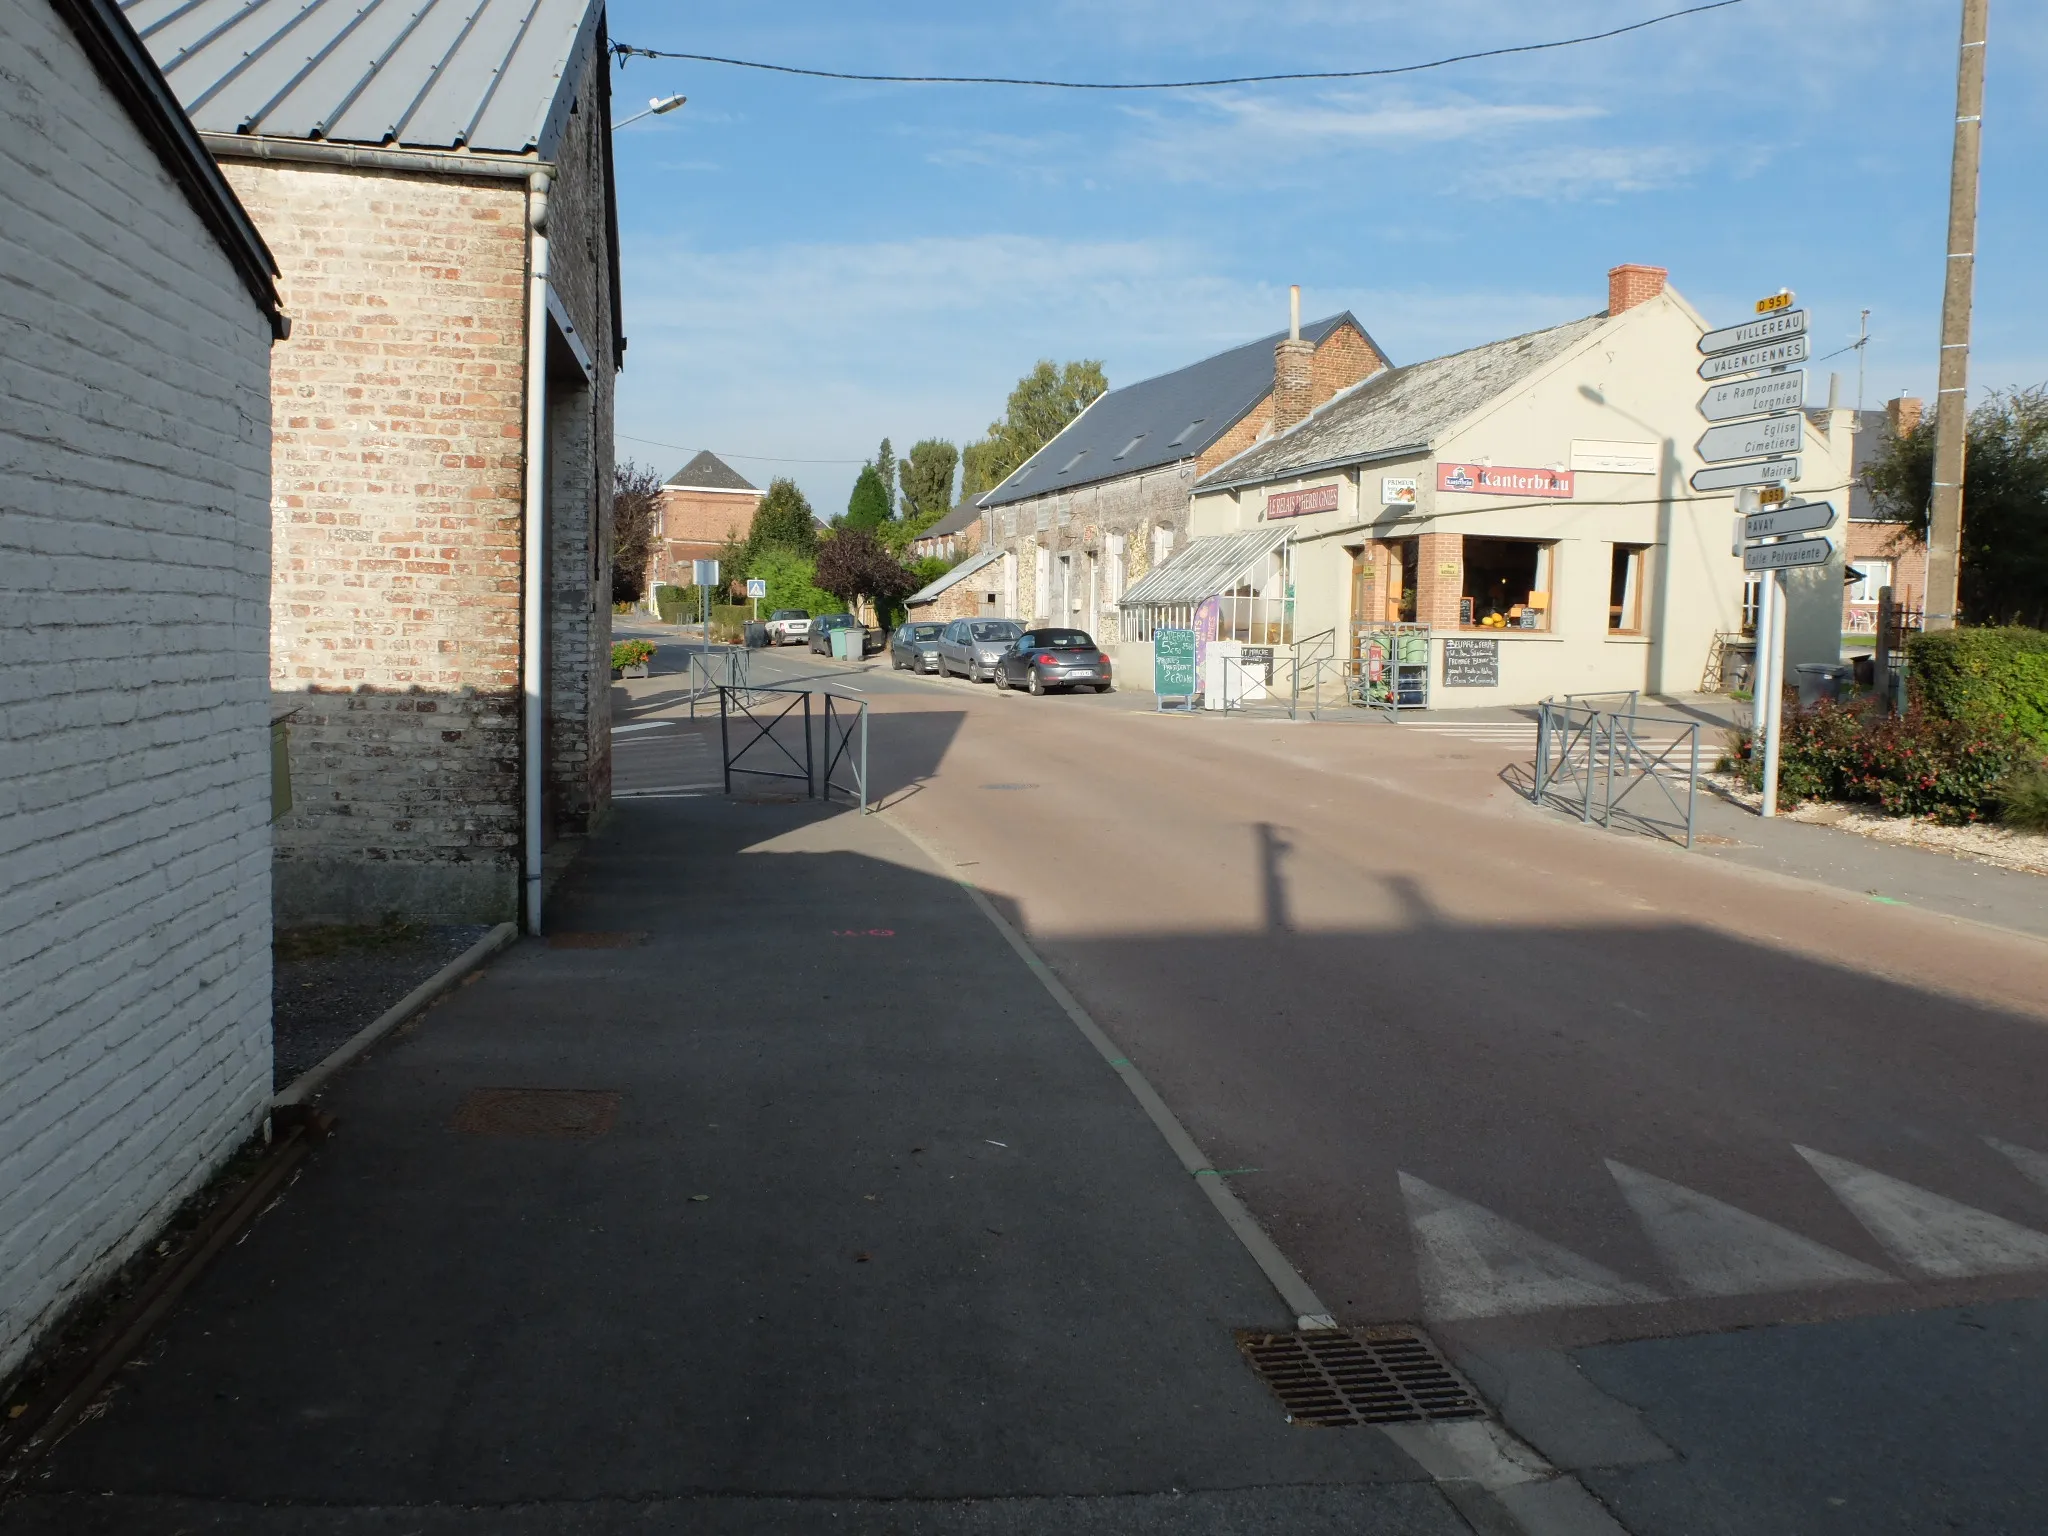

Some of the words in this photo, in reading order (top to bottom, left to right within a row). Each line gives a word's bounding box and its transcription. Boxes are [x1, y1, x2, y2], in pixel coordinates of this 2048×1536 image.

[1758, 300, 1764, 312] D
[1768, 294, 1788, 308] 951
[1736, 315, 1799, 341] VILLEREAU
[1714, 345, 1800, 373] VALENCIENNES
[1717, 391, 1727, 401] Le
[1733, 379, 1798, 400] Ramponneau
[1753, 394, 1797, 411] Lorgnies
[1761, 464, 1793, 478] Mairie
[1269, 500, 1276, 515] LE
[1276, 496, 1294, 514] RELAIS
[1772, 548, 1820, 564] Polyvalente
